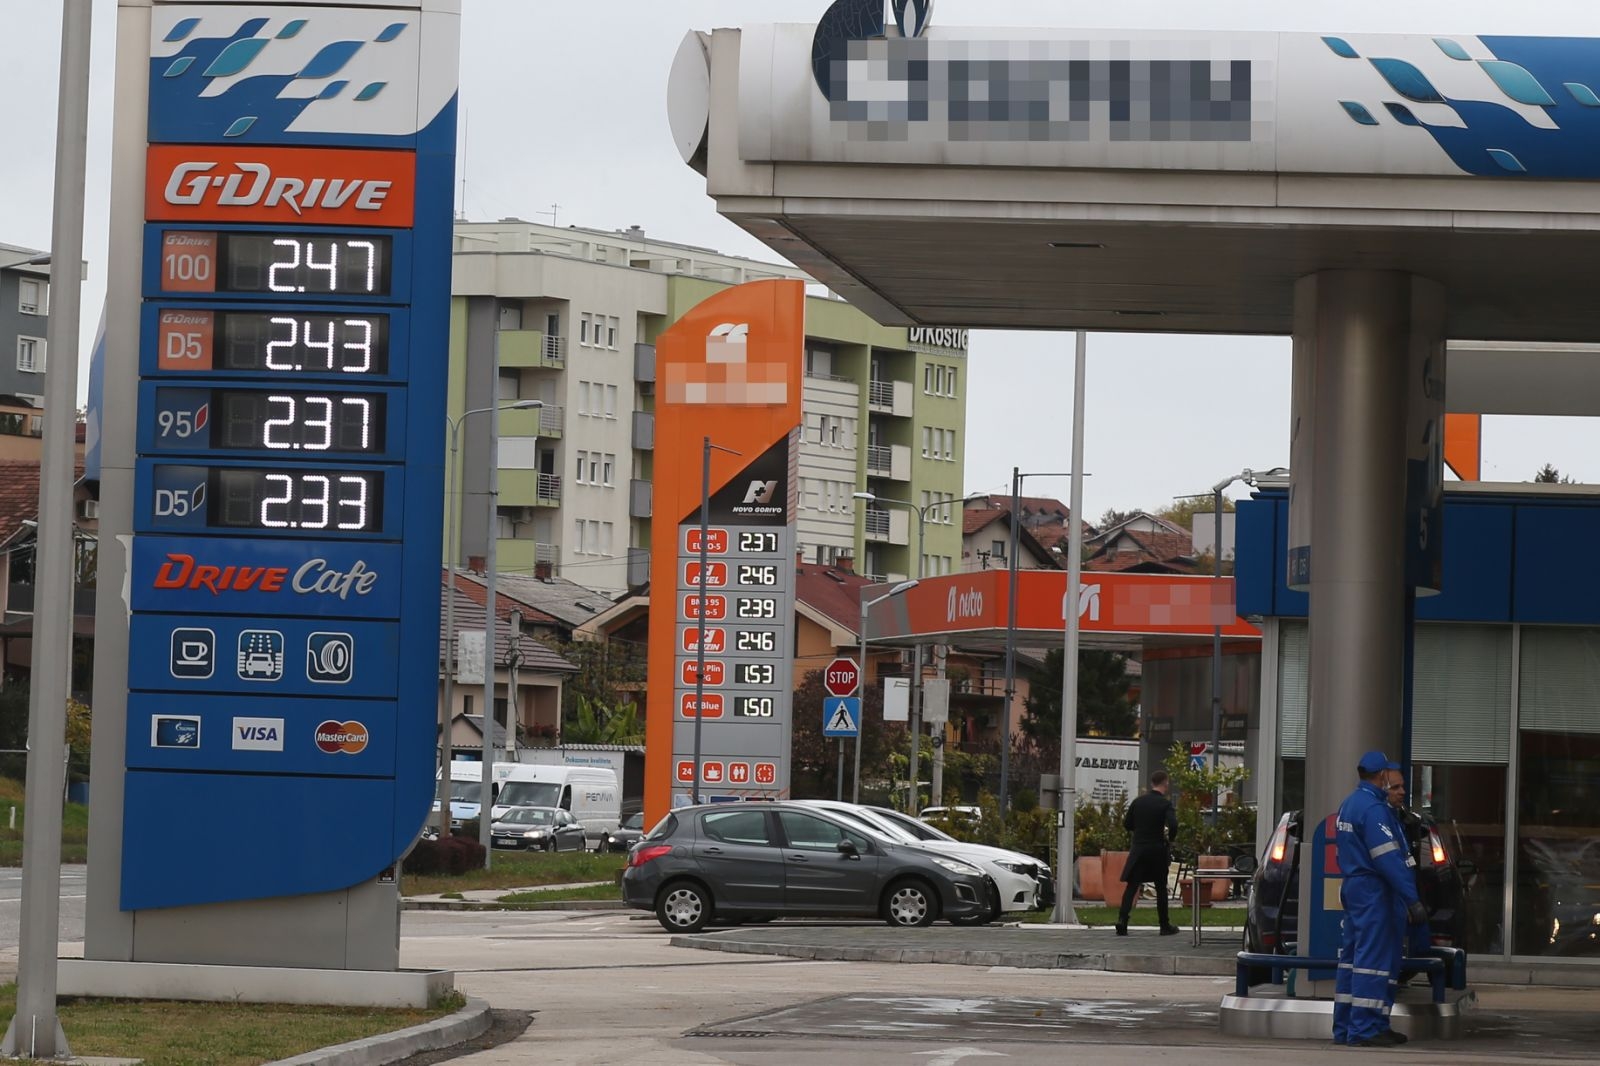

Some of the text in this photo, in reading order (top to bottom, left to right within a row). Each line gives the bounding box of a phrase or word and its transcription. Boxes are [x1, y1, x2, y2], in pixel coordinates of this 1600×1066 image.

[166, 254, 210, 280] 100
[269, 239, 374, 292] 2.47
[166, 332, 202, 359] D5
[266, 317, 371, 372] 2.43
[158, 411, 191, 438] 95
[263, 396, 369, 450] 2.37
[155, 490, 189, 516] D5
[261, 474, 367, 529] 2.33
[740, 533, 776, 552] 2.37
[154, 553, 288, 595] DRIVE
[740, 566, 775, 585] 2.46
[739, 599, 774, 618] 2.39
[738, 632, 773, 650] 2.46
[829, 671, 855, 684] STOP
[237, 726, 278, 741] VISA
[317, 732, 366, 742] MasterCard
